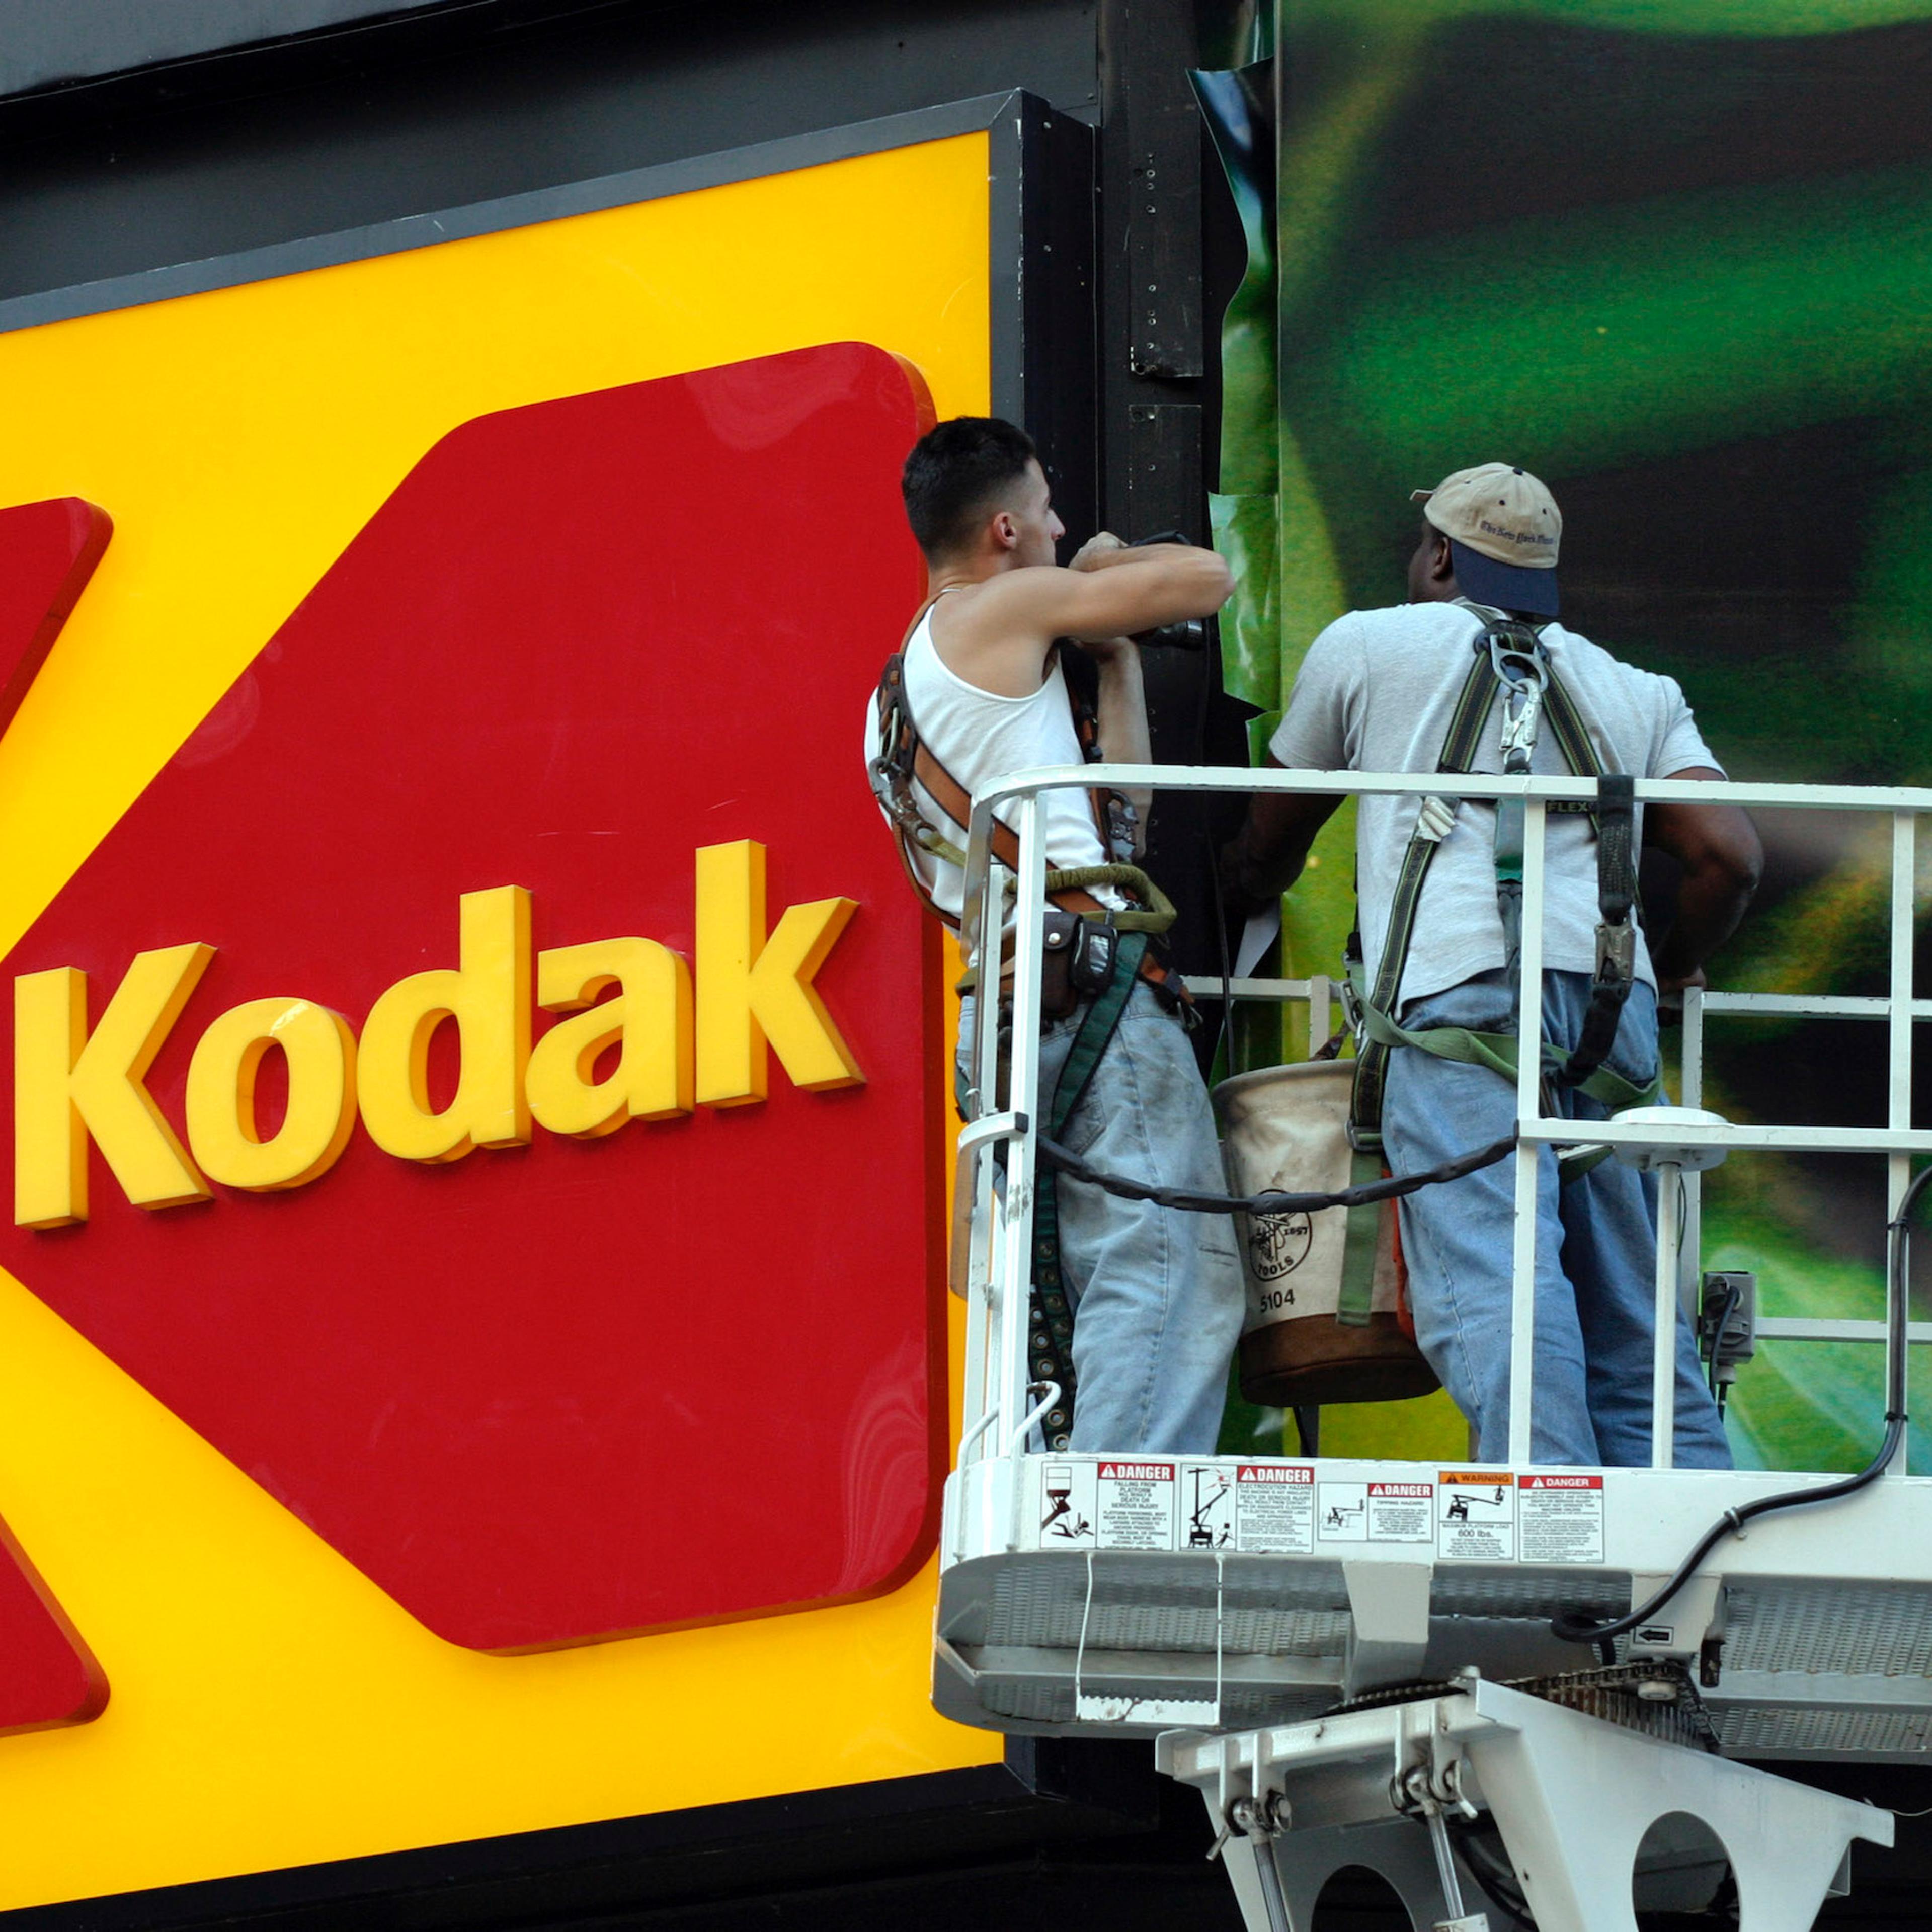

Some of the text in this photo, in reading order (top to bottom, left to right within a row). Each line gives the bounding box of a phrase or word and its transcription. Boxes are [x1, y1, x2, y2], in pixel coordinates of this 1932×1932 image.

[14, 838, 866, 1231] Kodak
[1257, 1255, 1294, 1276] TOOLS
[1260, 1288, 1296, 1313] 5104
[1117, 1465, 1170, 1479] DANGER
[1257, 1468, 1310, 1482] DANGER
[1461, 1474, 1509, 1482] WARNING
[1546, 1478, 1589, 1486] DANGER
[1385, 1485, 1431, 1496] DANGER
